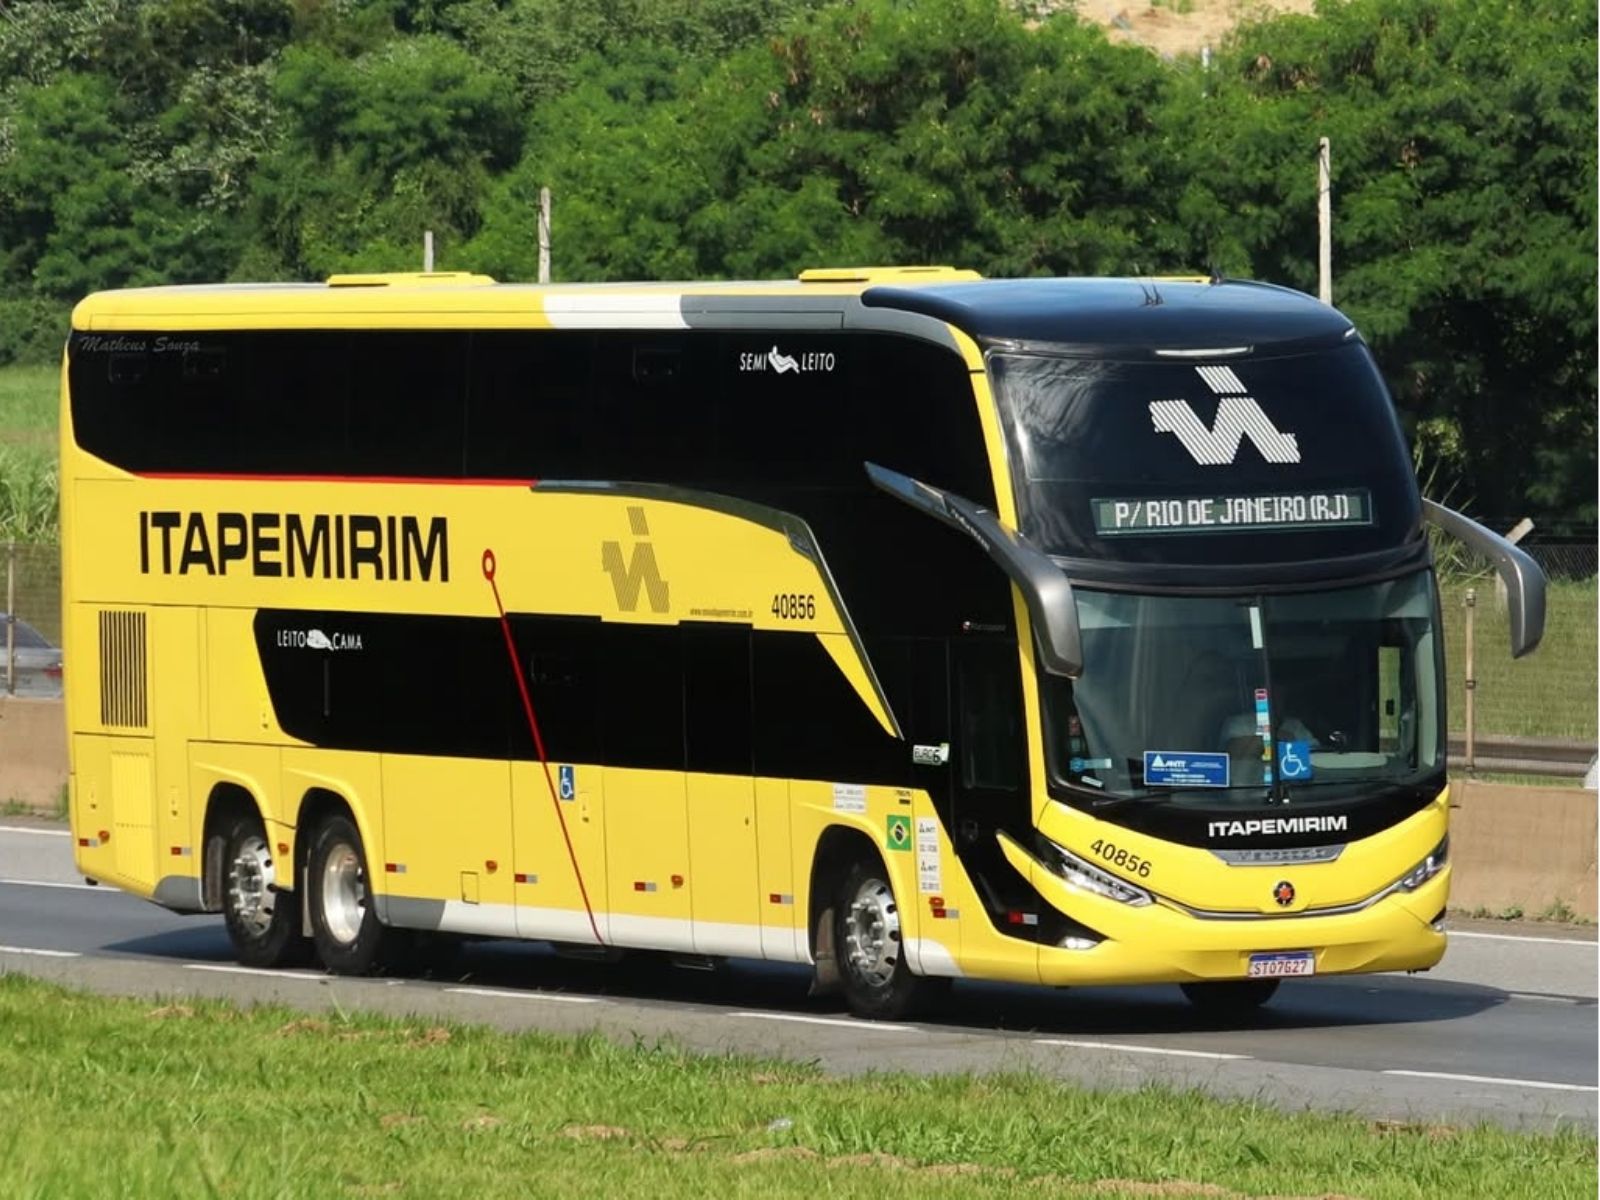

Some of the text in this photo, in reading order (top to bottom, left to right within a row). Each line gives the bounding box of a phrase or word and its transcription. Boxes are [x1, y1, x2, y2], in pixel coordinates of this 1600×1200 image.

[740, 352, 835, 372] SEMI LEITO
[1115, 495, 1349, 527] P/ RIO DE JANEIRO (RJ)
[139, 511, 450, 583] ITAPEMIRIM
[771, 593, 816, 619] 40856
[277, 630, 363, 650] LEITO CAMA
[1208, 815, 1348, 837] ITAPEMIRIM
[1090, 839, 1153, 878] 40856
